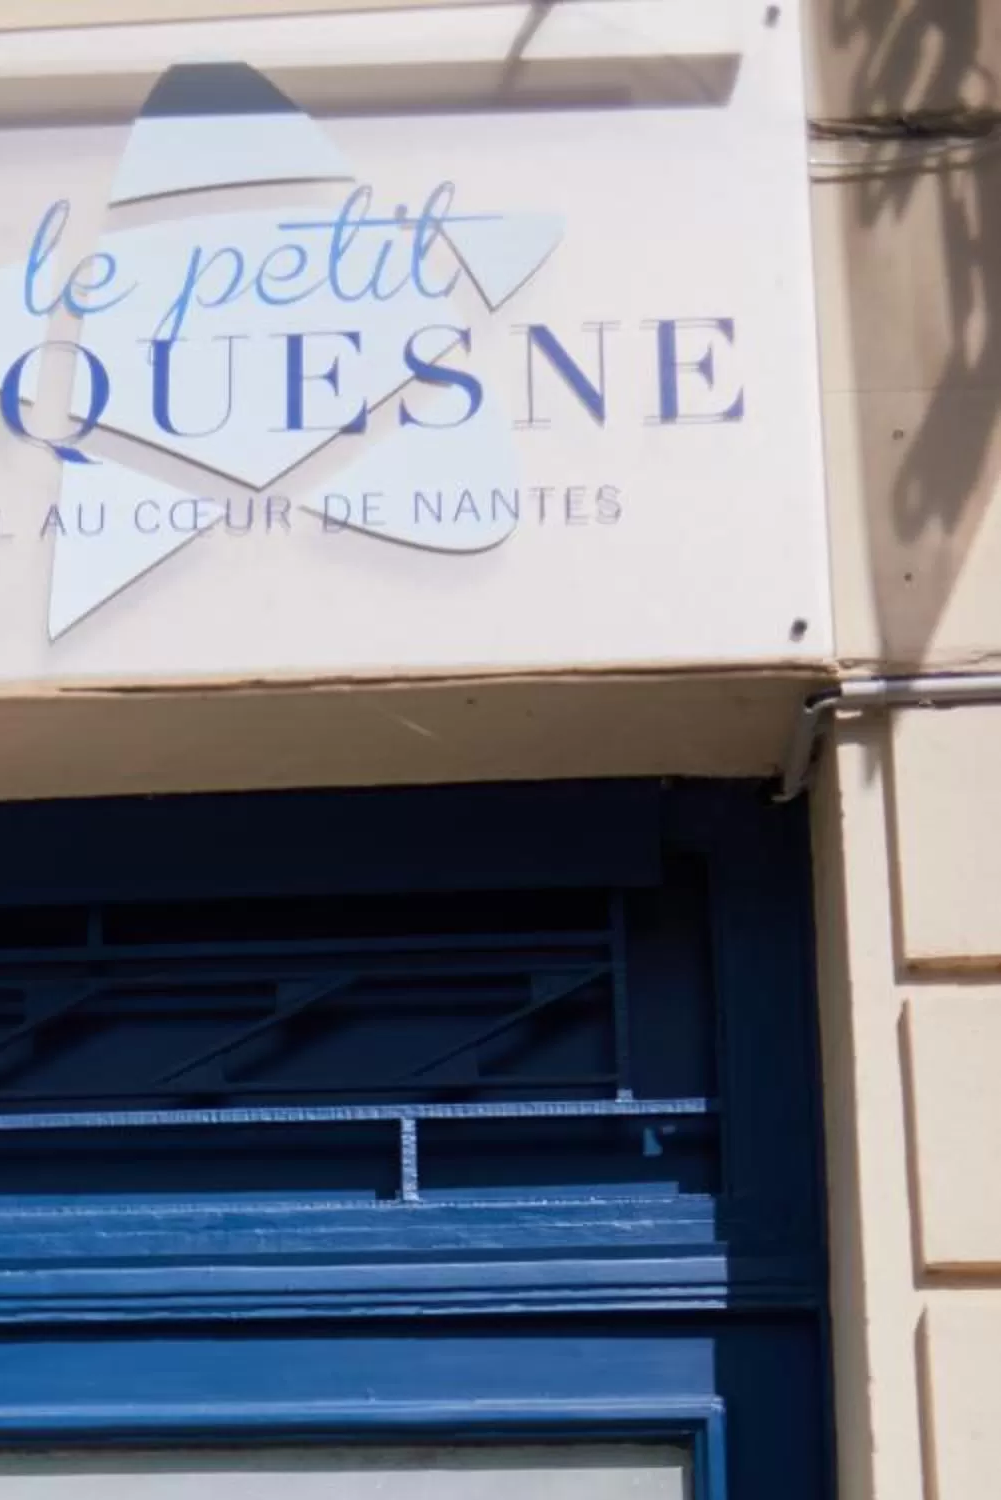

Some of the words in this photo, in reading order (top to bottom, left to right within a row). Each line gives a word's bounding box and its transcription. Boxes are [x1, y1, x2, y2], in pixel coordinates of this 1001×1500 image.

[25, 199, 138, 318] le
[147, 180, 503, 367] petit
[39, 500, 105, 542] AU
[133, 493, 293, 539] CŒUR
[321, 489, 388, 534] DE
[412, 483, 625, 527] NANTES
